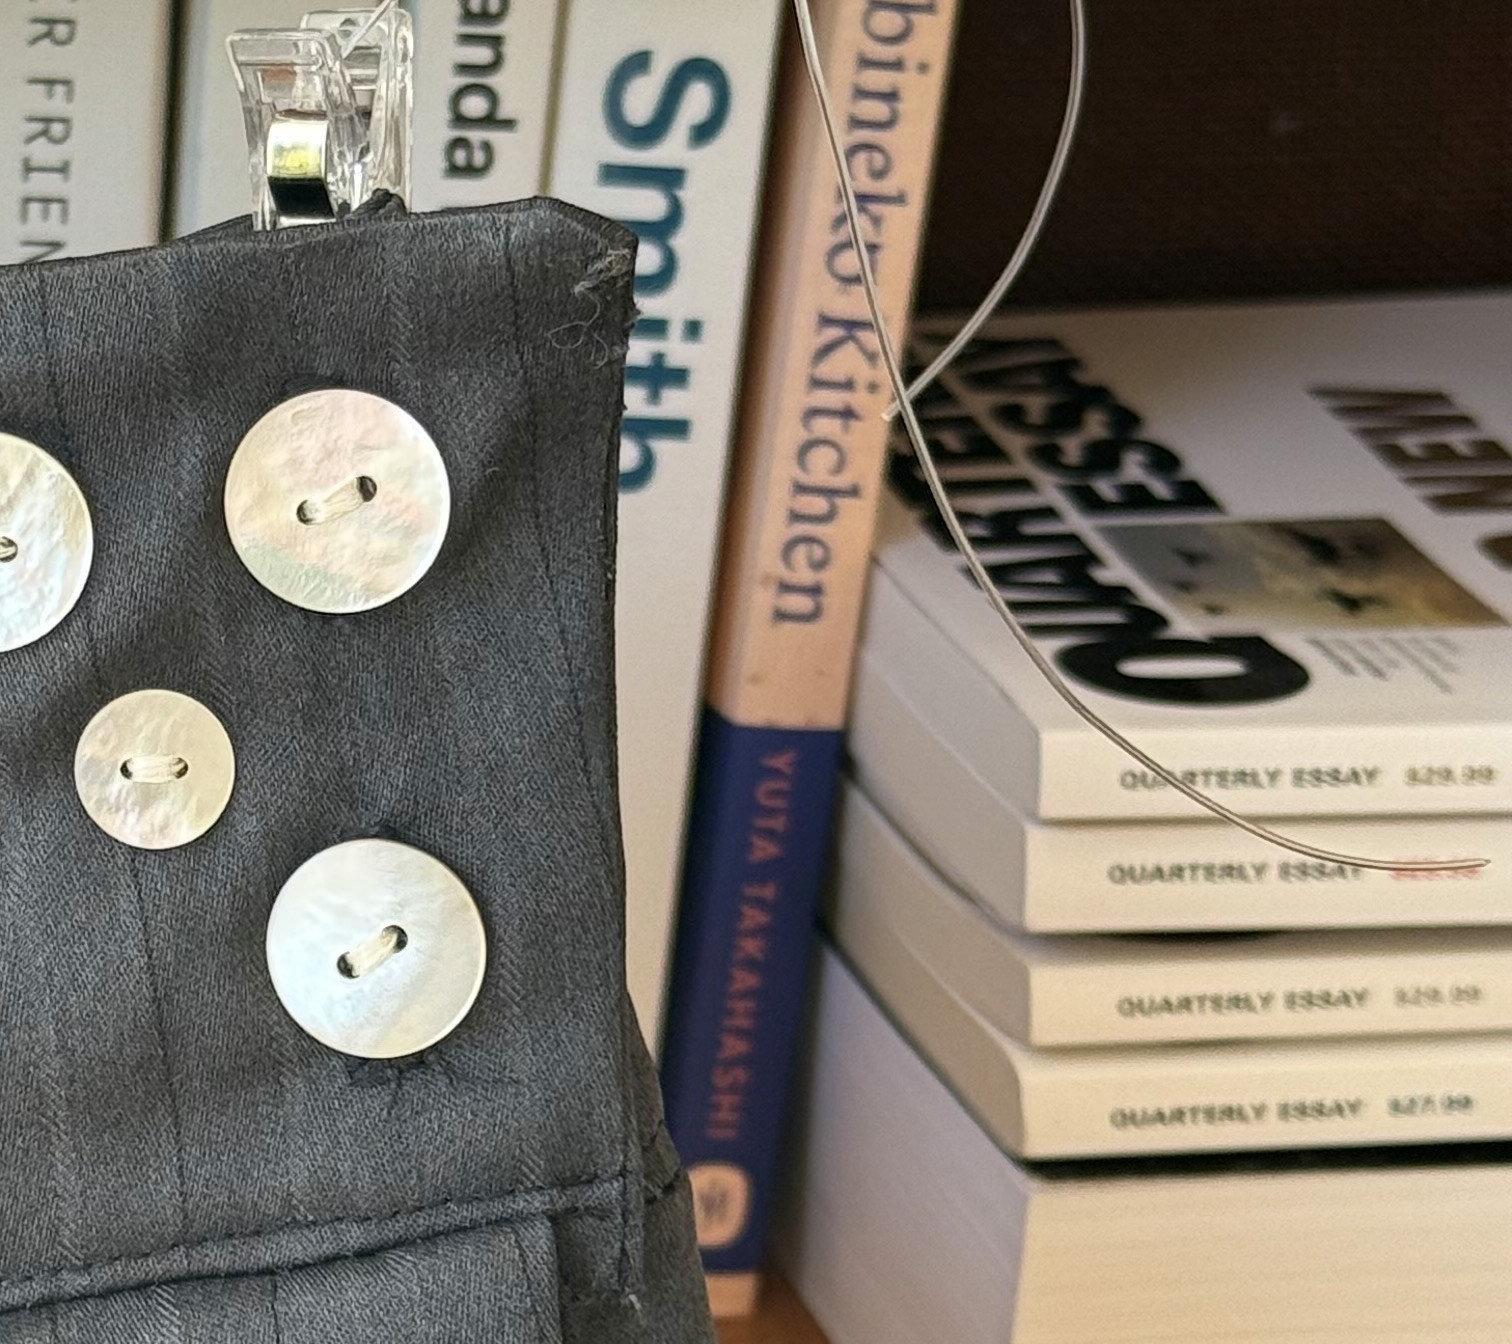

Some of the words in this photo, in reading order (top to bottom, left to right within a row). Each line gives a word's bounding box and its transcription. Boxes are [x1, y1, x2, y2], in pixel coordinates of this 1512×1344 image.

[772, 313, 882, 628] Kitchen
[1119, 766, 1282, 791] QUARTERLY
[1290, 765, 1381, 788] ESSAY
[749, 749, 796, 865] YUTA
[1106, 861, 1269, 886] QUARTERLY
[705, 881, 778, 1143] TAKAHASHI
[1116, 991, 1275, 1018] QUARTERLY
[1284, 987, 1370, 1013] ESSAY
[1108, 1102, 1268, 1130] QUARTERLY
[1277, 1097, 1363, 1122] ESSAY
